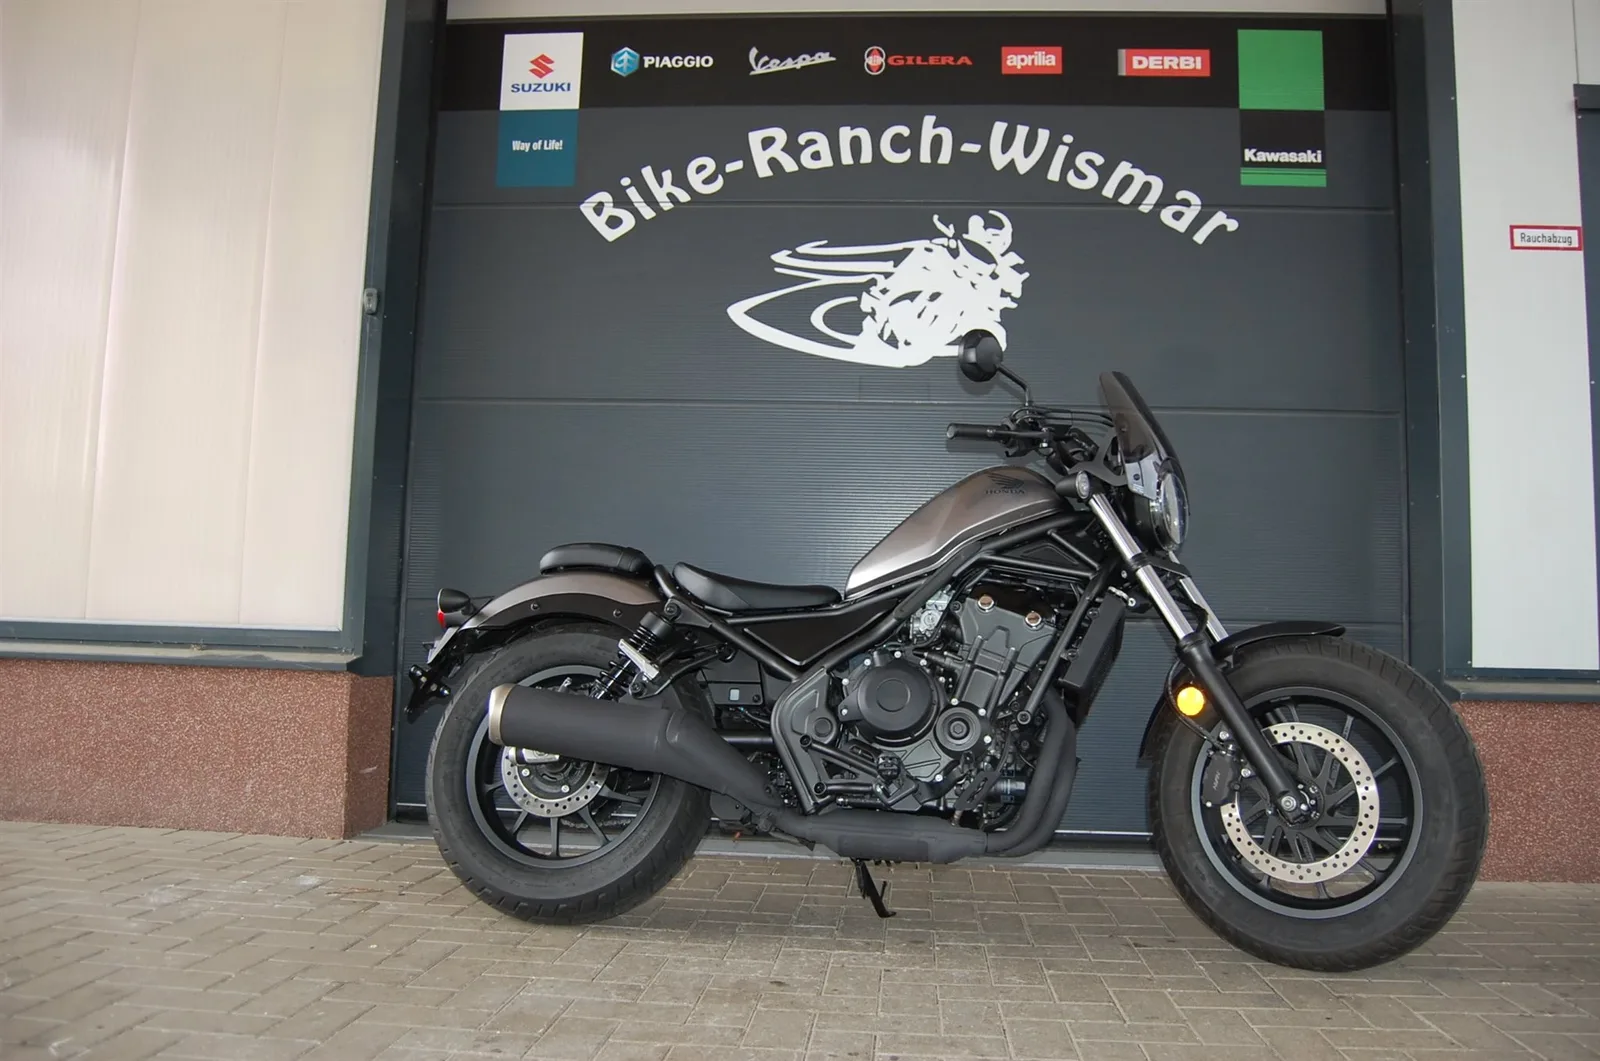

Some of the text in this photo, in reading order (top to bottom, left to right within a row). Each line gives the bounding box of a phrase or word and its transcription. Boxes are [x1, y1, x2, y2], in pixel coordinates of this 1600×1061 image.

[643, 55, 714, 68] PIAGGIO
[749, 46, 836, 75] Vespa
[887, 55, 973, 66] GILERA
[1006, 51, 1056, 69] aprilia
[1132, 56, 1202, 70] DERBI
[511, 82, 571, 93] SUZUKI
[512, 139, 563, 153] Way of Life!
[1244, 148, 1323, 164] Kawasaki
[579, 115, 1240, 245] Bike-Ranch-Wismar
[1520, 232, 1573, 246] Rauchabzug
